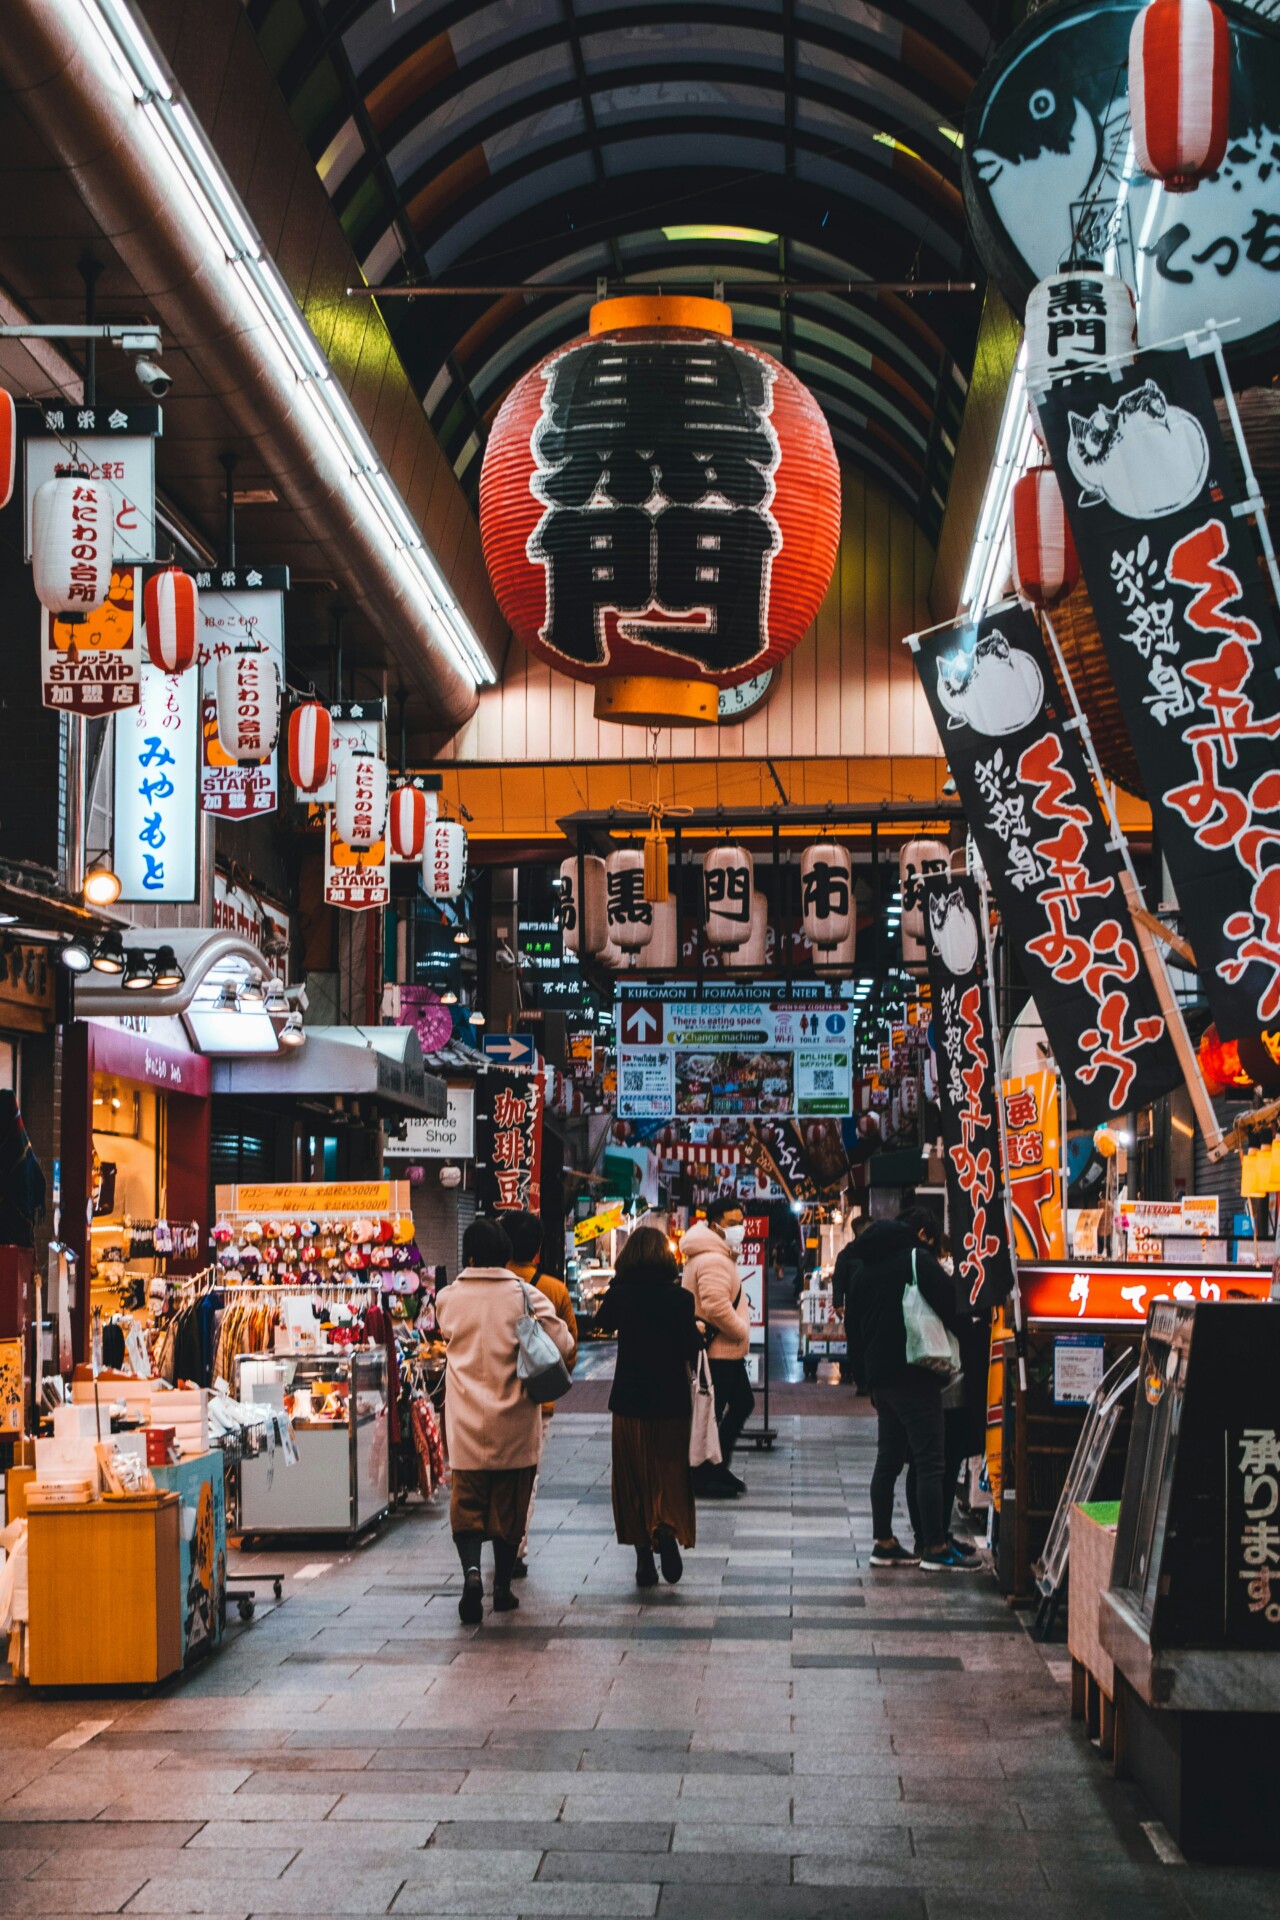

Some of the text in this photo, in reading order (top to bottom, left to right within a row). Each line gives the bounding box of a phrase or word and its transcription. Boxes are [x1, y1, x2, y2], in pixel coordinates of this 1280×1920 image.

[526, 339, 783, 674] 黒門
[68, 486, 98, 603] なにわの台所
[50, 665, 133, 681] STAMP
[51, 685, 134, 703] 加盟店
[237, 658, 261, 749] なにわの台所
[204, 778, 271, 791] STAMP
[352, 762, 374, 838] なにわの台所
[138, 737, 175, 890] みやもと
[330, 876, 384, 886] STAMP
[705, 867, 750, 923] 門
[803, 862, 850, 919] 市
[628, 988, 818, 998] KUROMON IFORMATION CNTER
[670, 1004, 762, 1015] FREE REST AREA
[673, 1016, 760, 1026] There is eating space
[685, 1031, 760, 1043] Change machine
[775, 1034, 793, 1043] Wi-Fi
[410, 1117, 456, 1127] Tax-free
[426, 1130, 457, 1144] Shop
[492, 1088, 527, 1210] 珈琲豆
